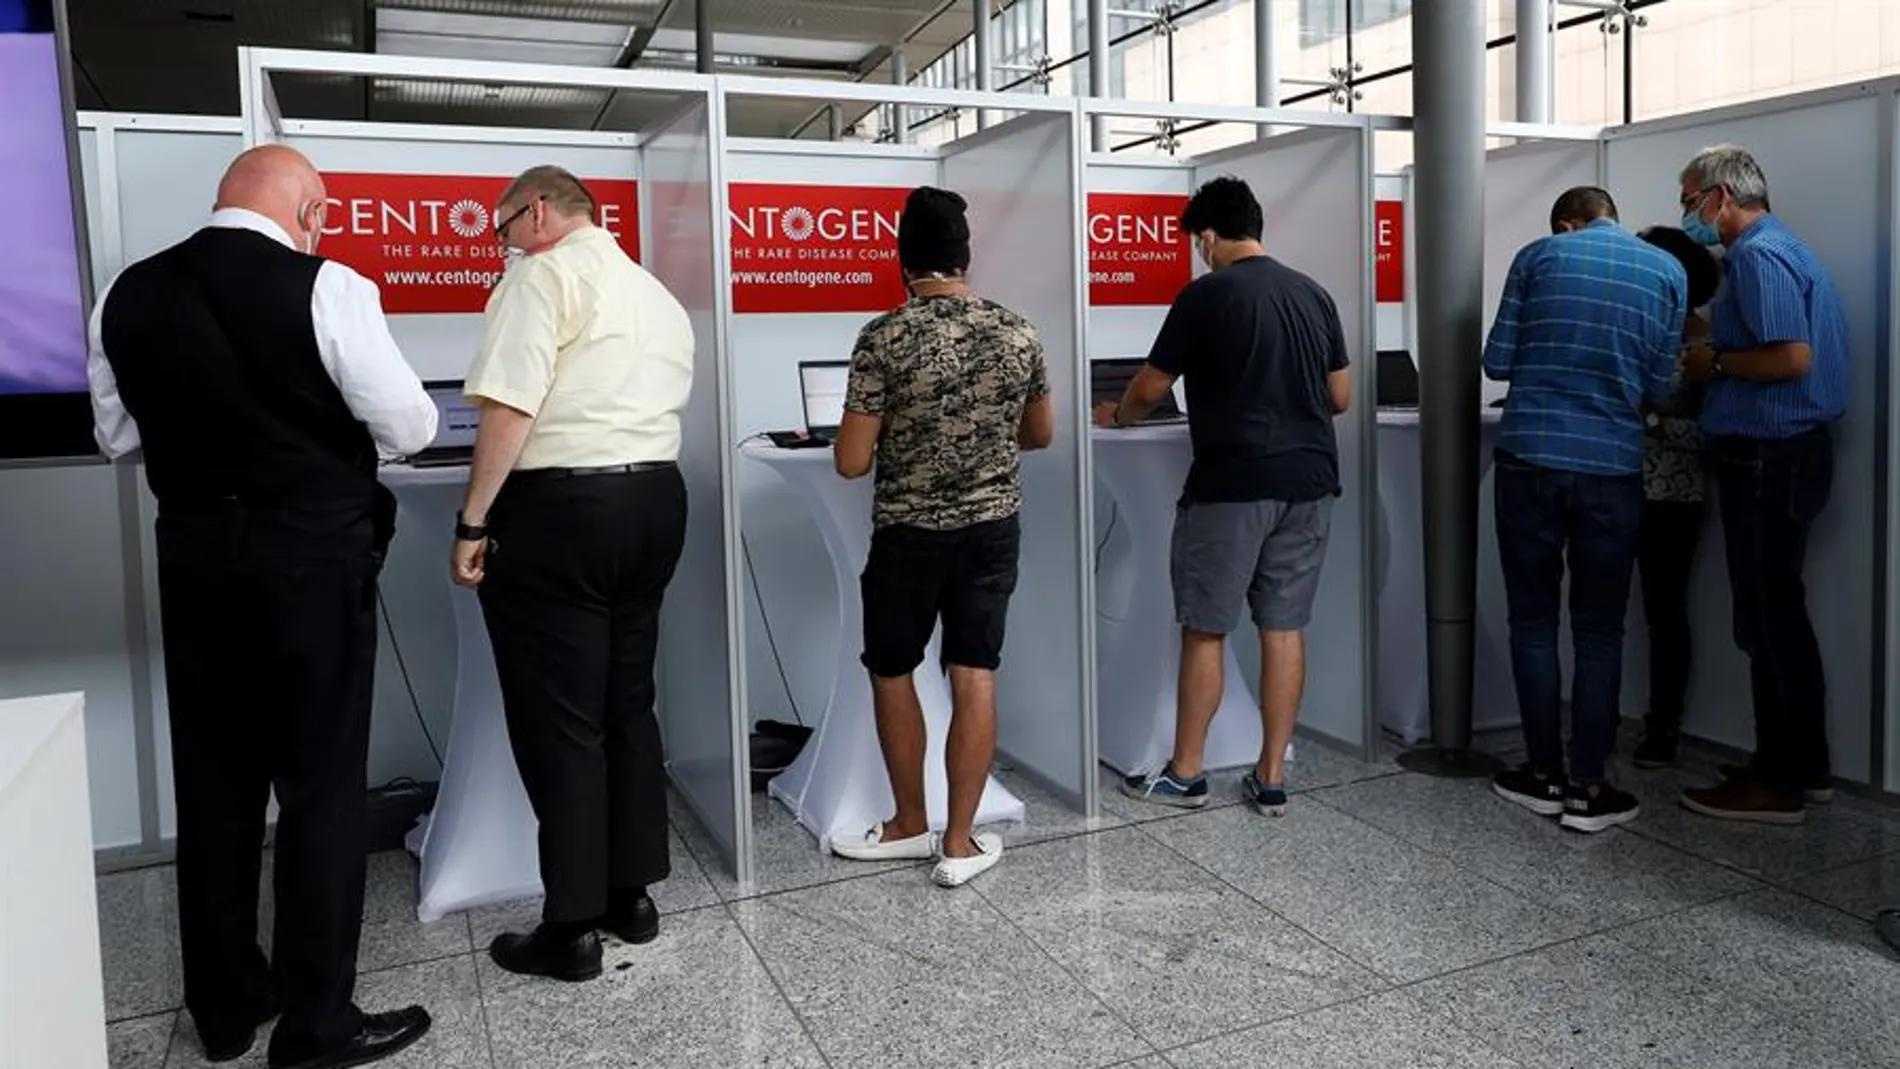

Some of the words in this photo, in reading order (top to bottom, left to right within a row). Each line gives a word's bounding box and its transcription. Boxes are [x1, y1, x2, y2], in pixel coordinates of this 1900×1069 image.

[1088, 213, 1179, 244] GENE
[1378, 219, 1392, 246] E
[383, 244, 412, 257] THE
[421, 244, 463, 257] RARE
[733, 247, 752, 260] HE
[757, 247, 792, 260] RARE
[797, 247, 853, 261] DISEASE
[1123, 250, 1178, 262] COMPANY
[731, 270, 873, 288] www.centogene.com
